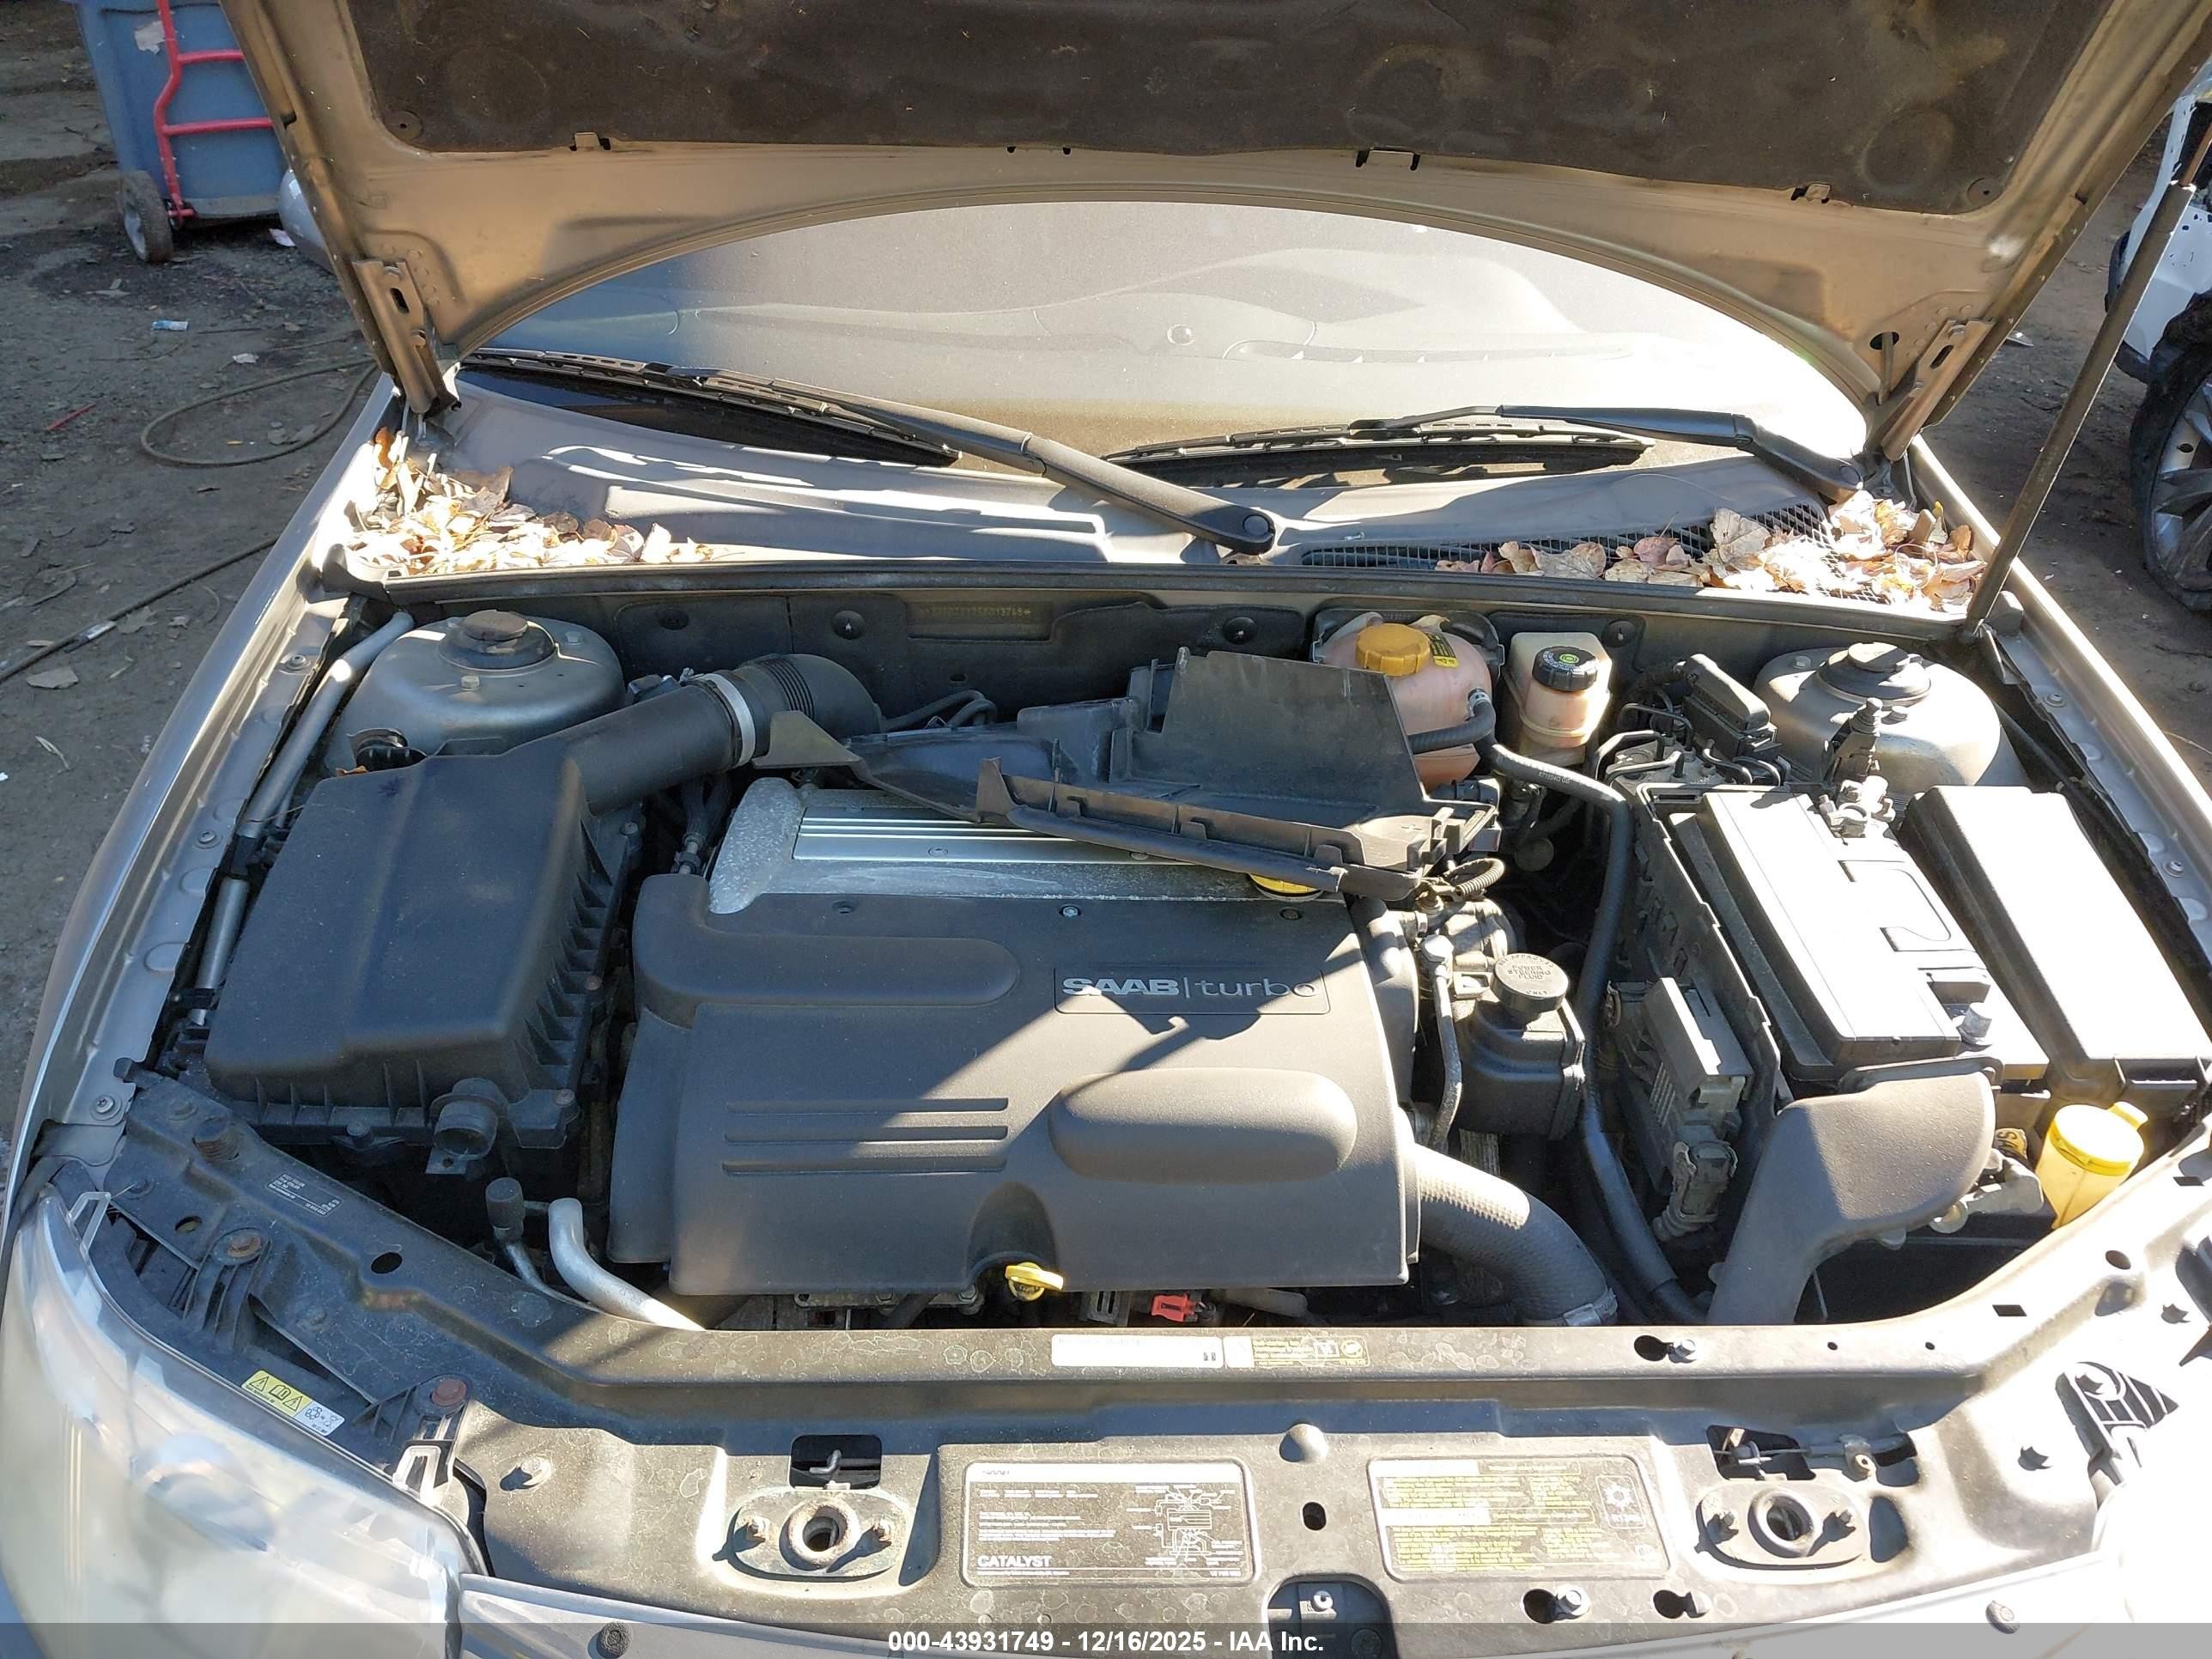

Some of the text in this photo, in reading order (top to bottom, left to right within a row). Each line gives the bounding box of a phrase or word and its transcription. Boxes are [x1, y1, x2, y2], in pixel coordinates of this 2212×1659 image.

[1062, 977, 1318, 997] SAAB turbo
[977, 1554, 1053, 1568] CATALYST
